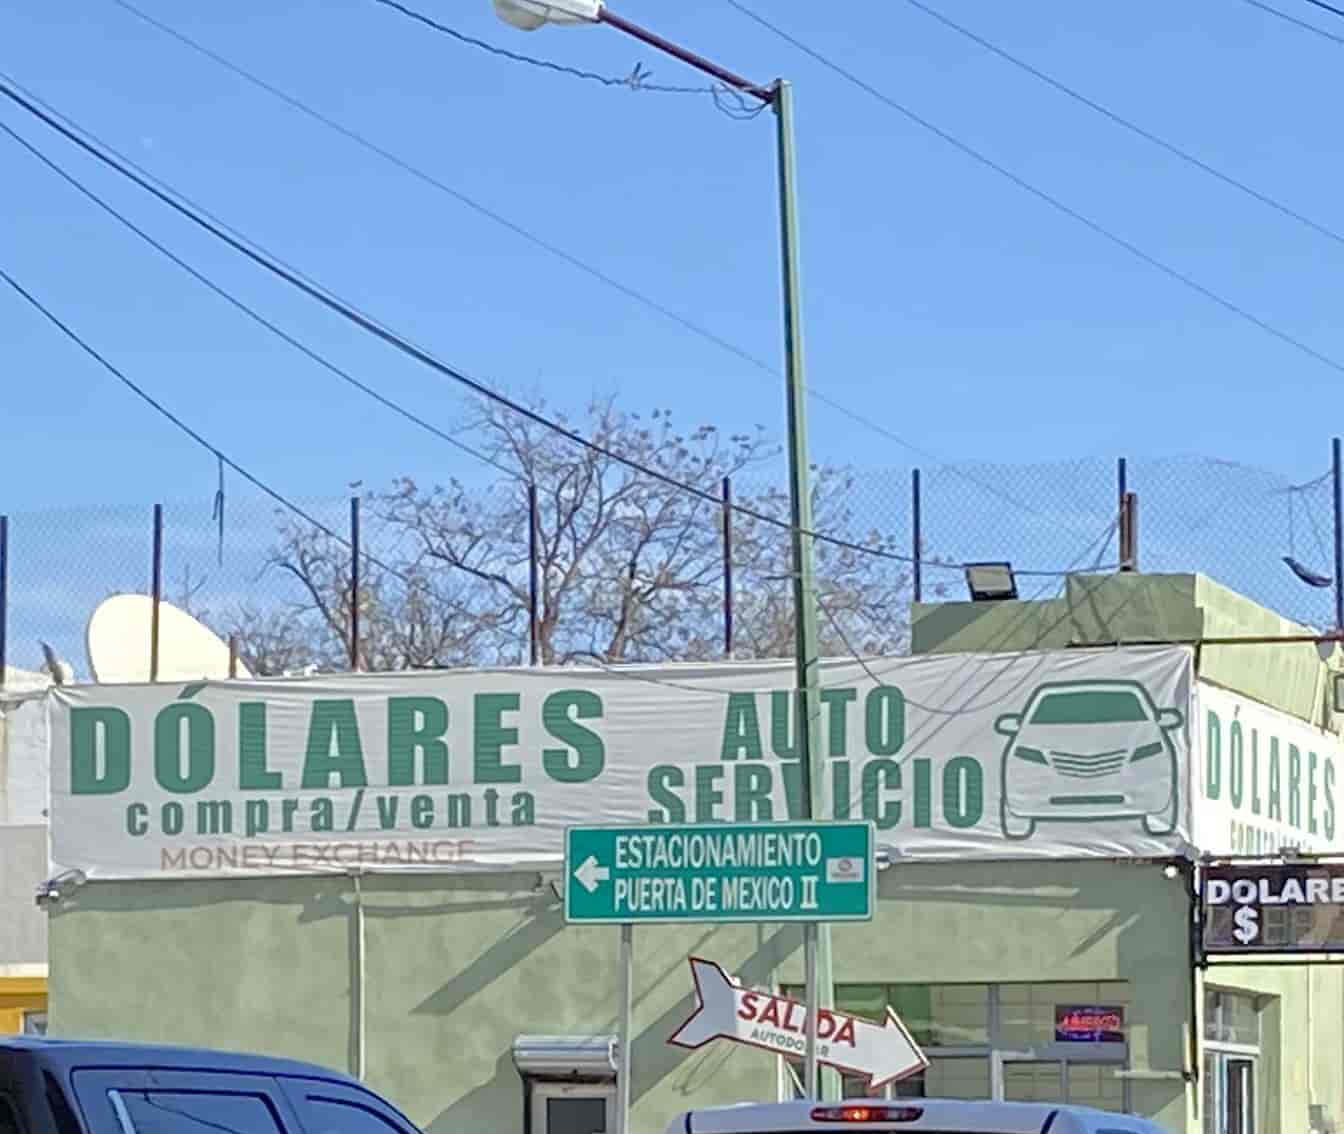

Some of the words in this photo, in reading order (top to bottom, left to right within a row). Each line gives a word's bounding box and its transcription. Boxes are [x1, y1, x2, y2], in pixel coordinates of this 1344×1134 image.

[69, 684, 606, 796] DÓLARES
[720, 685, 906, 761] AUTO
[647, 756, 984, 831] SERVICIO
[1205, 704, 1337, 843] DÓLARES
[125, 788, 536, 839] compra/venta
[160, 845, 285, 872] MONEY
[289, 840, 477, 867] EXCHANGE
[614, 832, 822, 869] ESTACIONAMIENTO
[614, 877, 687, 912] PUERTA
[692, 877, 717, 911] DE
[722, 876, 793, 911] MEXICO
[800, 875, 819, 909] II
[751, 1027, 830, 1059] AUTODOR
